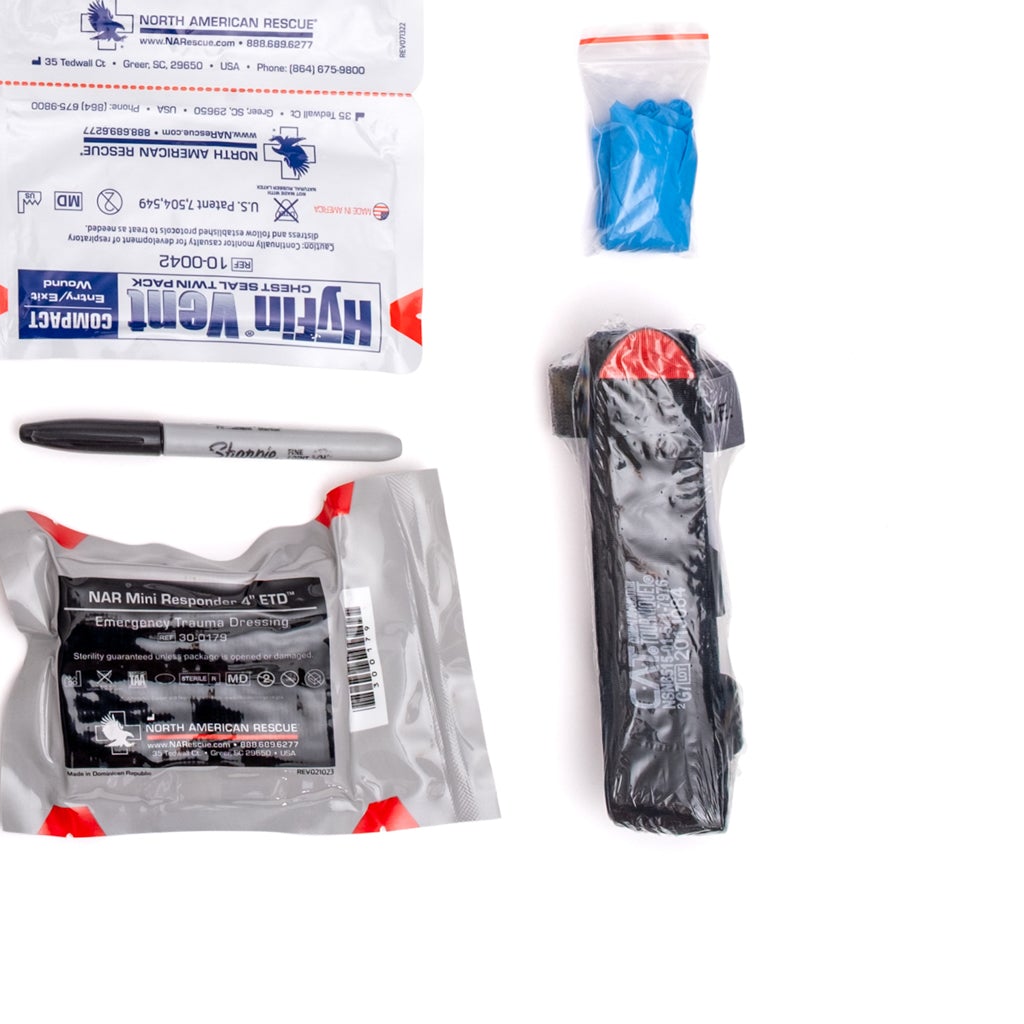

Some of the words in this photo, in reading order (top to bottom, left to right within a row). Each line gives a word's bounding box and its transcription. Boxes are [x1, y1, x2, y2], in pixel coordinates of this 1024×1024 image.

[140, 15, 184, 26] NORTH
[190, 16, 258, 28] AMERICAN
[140, 37, 235, 48] www.NARescue.com
[247, 40, 313, 49] 888.689.6277
[60, 58, 93, 67] Tedwall
[95, 59, 106, 67] Ct
[123, 60, 150, 70] Greer,
[153, 61, 167, 70] SC,
[171, 61, 202, 69] 29650
[257, 63, 287, 73] Phone:
[289, 65, 315, 75] (864)
[318, 65, 365, 74] 675-9800
[139, 147, 209, 159] AMERICAN
[213, 150, 258, 161] NORTH
[159, 255, 228, 269] 10-0042
[43, 279, 92, 289] Wound
[31, 291, 105, 303] Entry/Exit
[127, 289, 239, 337] Vent
[29, 311, 112, 329] COMPACT
[89, 591, 122, 604] NAR
[126, 593, 156, 604] Mini
[162, 594, 237, 607] Responder
[95, 616, 170, 630] Emergency
[175, 617, 224, 628] Trauma
[230, 616, 289, 629] Dressing
[73, 653, 104, 662] Sterility
[106, 653, 154, 662] guaranteed
[184, 653, 220, 662] package
[230, 653, 262, 662] opened
[273, 652, 314, 661] damaged.
[677, 667, 687, 681] LOT
[146, 723, 184, 733] NORTH
[189, 723, 249, 733] AMERICAN
[254, 723, 298, 732] RESCUE
